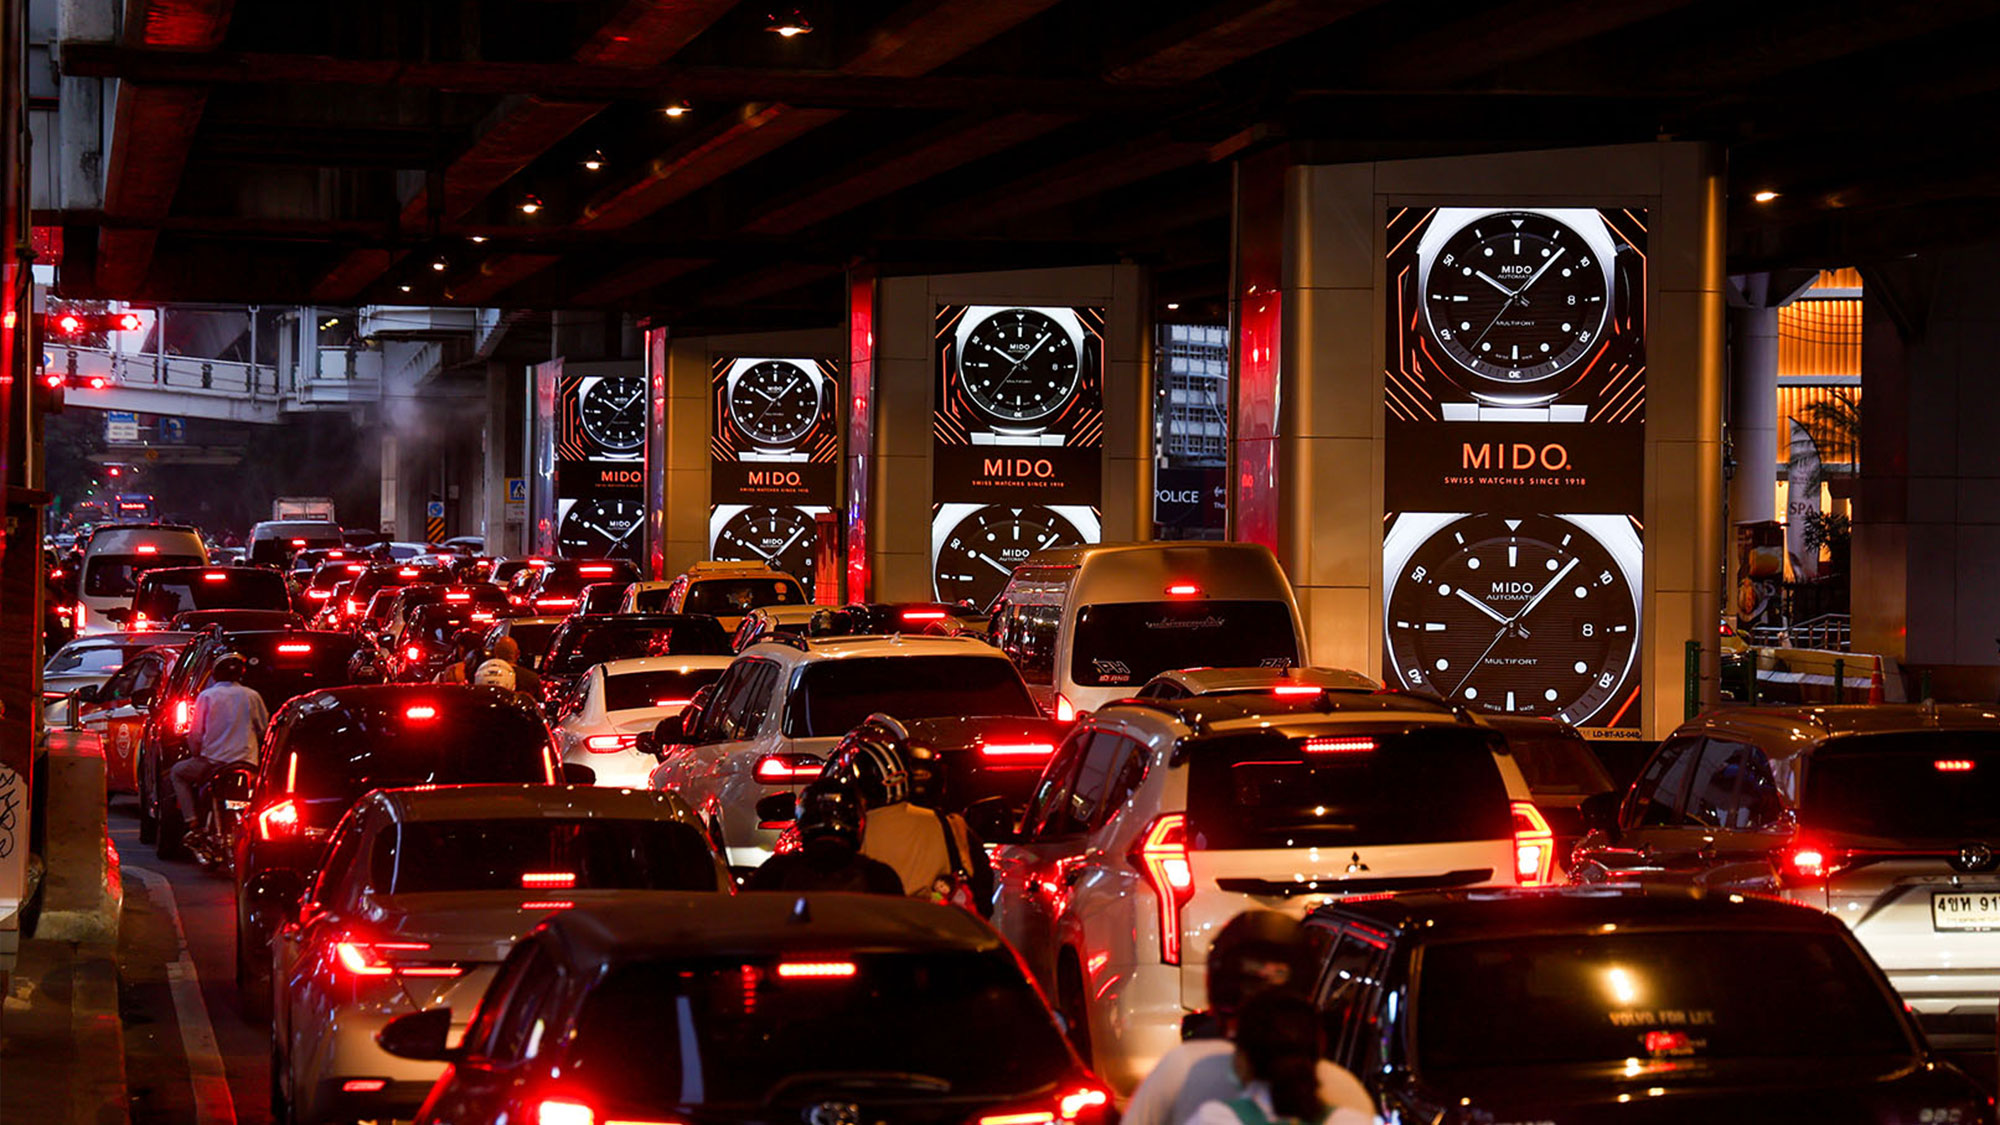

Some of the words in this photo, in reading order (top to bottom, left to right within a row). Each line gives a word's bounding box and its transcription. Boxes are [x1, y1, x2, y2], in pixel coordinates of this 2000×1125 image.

[1443, 254, 1455, 267] 50
[1579, 256, 1591, 267] 10
[1501, 265, 1533, 274] MIDO
[1567, 295, 1576, 305] 8
[1440, 329, 1452, 341] 40
[1579, 330, 1591, 343] 20
[1009, 343, 1031, 351] MIDO
[1444, 476, 1475, 485] SWISS
[1479, 477, 1525, 485] WATCHES
[1529, 477, 1560, 485] SINCE
[1565, 477, 1586, 486] 1918
[1789, 501, 1815, 516] SPA
[609, 520, 631, 528] MIDO
[1002, 549, 1030, 558] MIDO
[1411, 566, 1428, 583] 50
[1599, 570, 1614, 586] 10
[1492, 582, 1534, 593] MIDO
[1582, 623, 1594, 638] 8
[1484, 657, 1538, 666] MULTIFORT
[1407, 668, 1424, 685] 40
[1599, 671, 1615, 689] 20
[1980, 896, 2000, 912] 91
